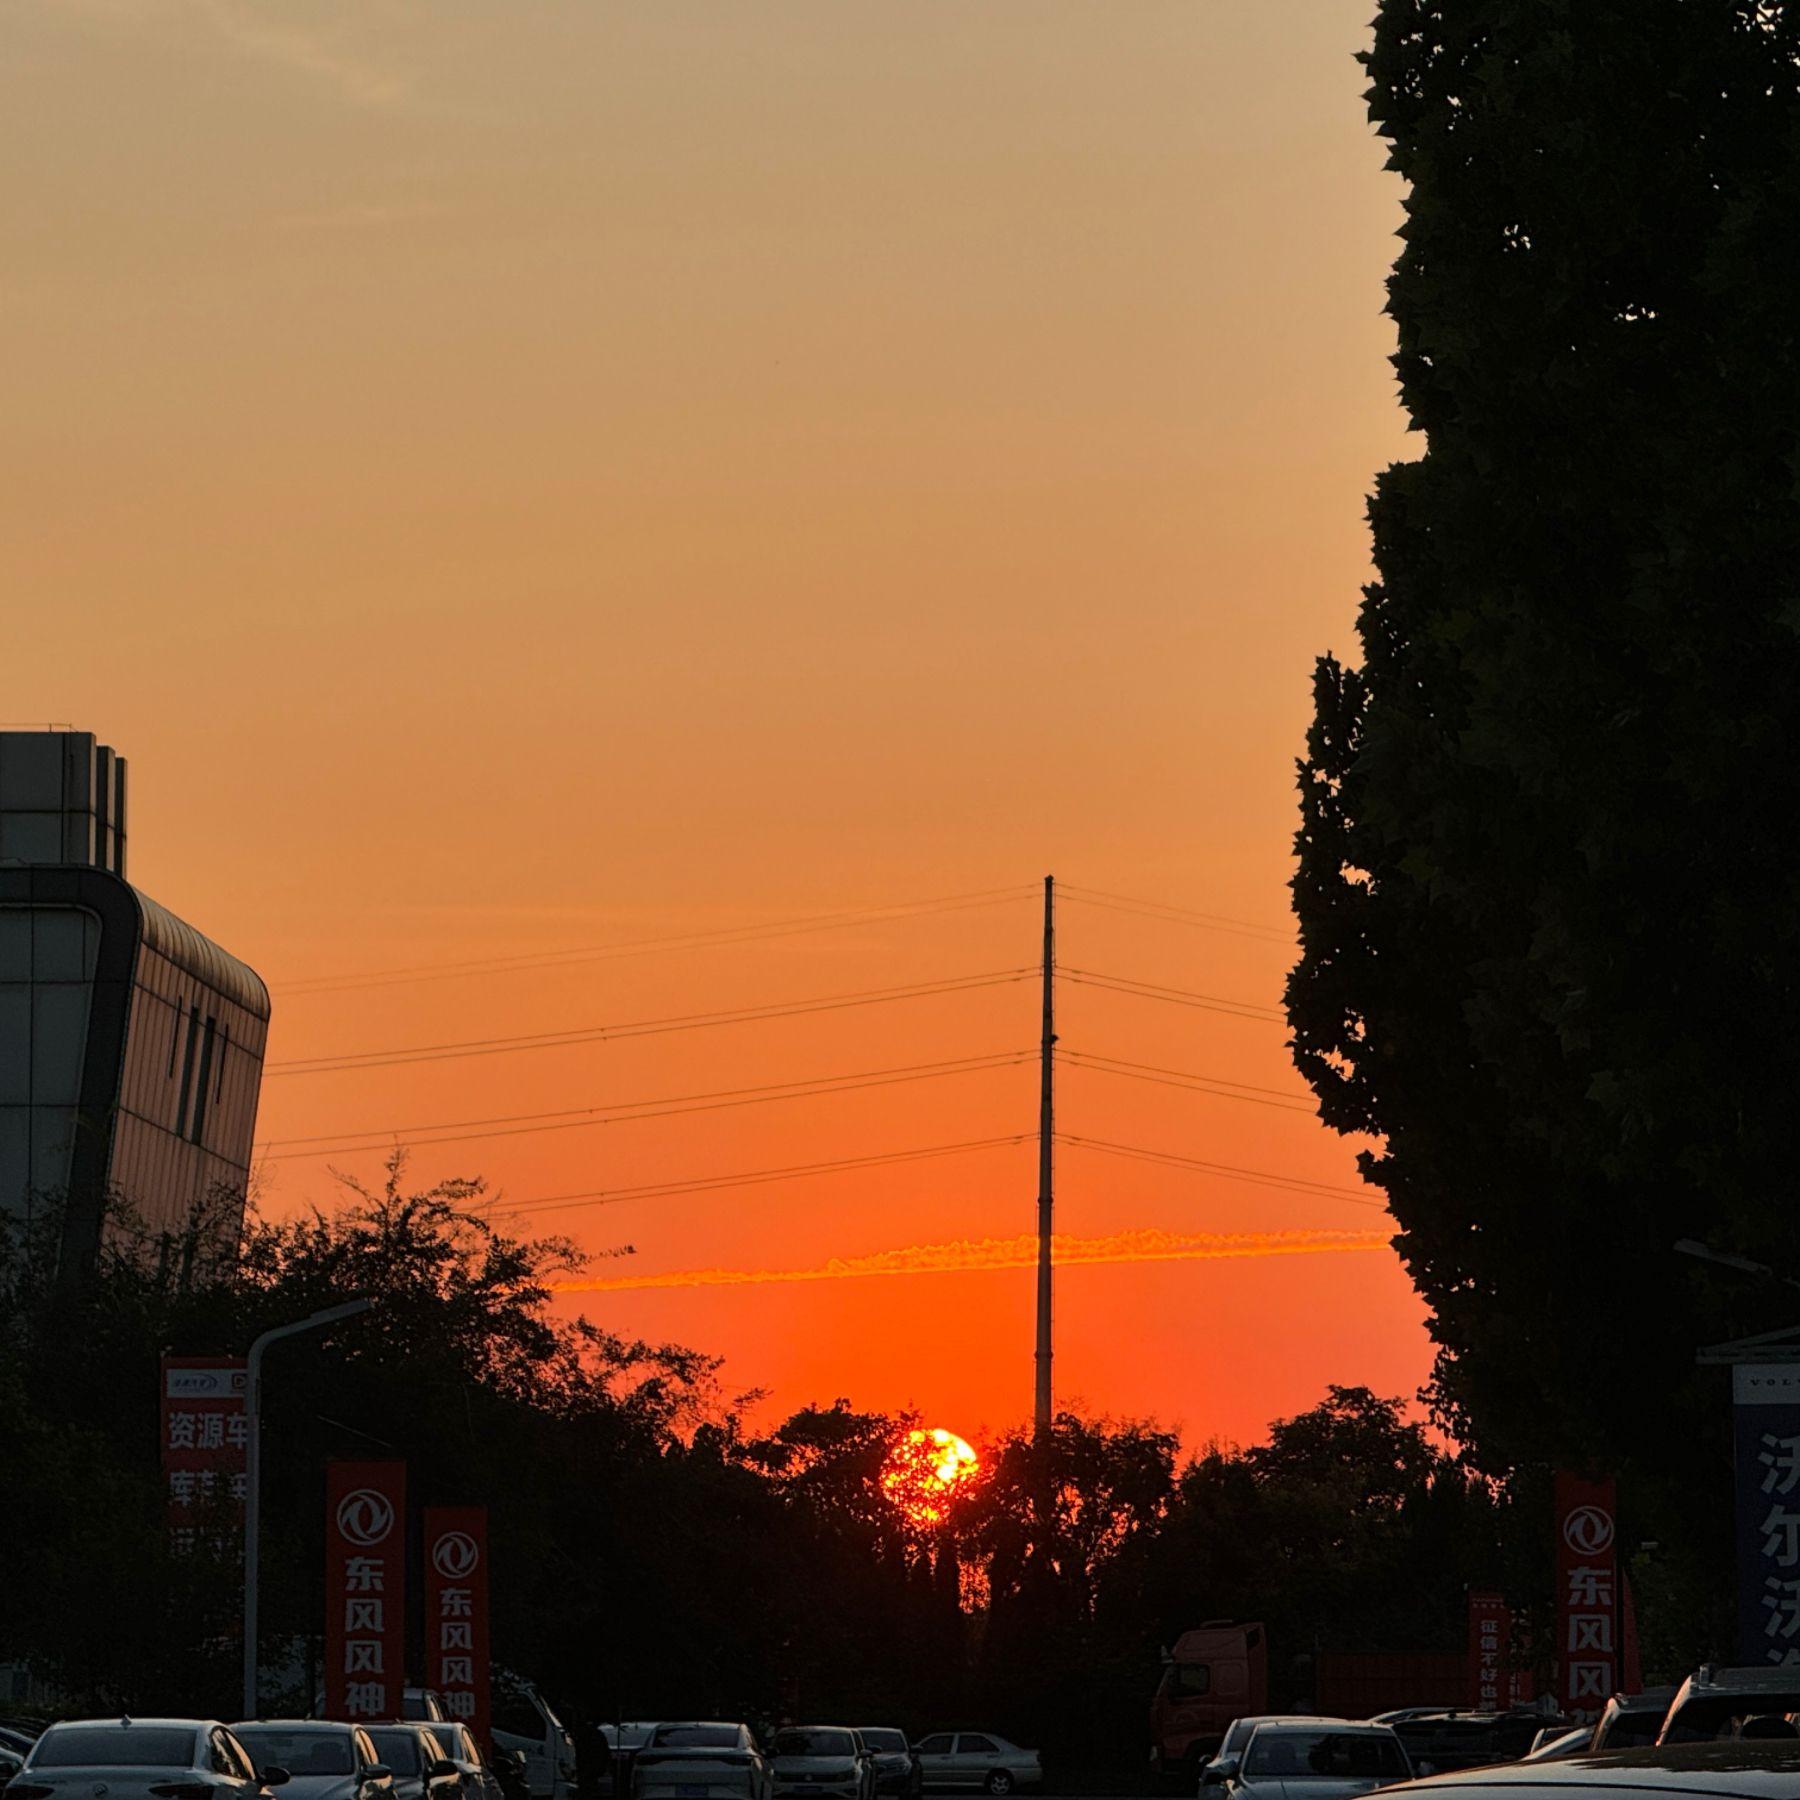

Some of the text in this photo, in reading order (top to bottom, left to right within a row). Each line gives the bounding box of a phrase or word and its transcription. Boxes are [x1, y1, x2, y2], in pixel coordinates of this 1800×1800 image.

[344, 1556, 385, 1716] 东风风神
[1757, 1434, 1800, 1664] 沃尔沃
